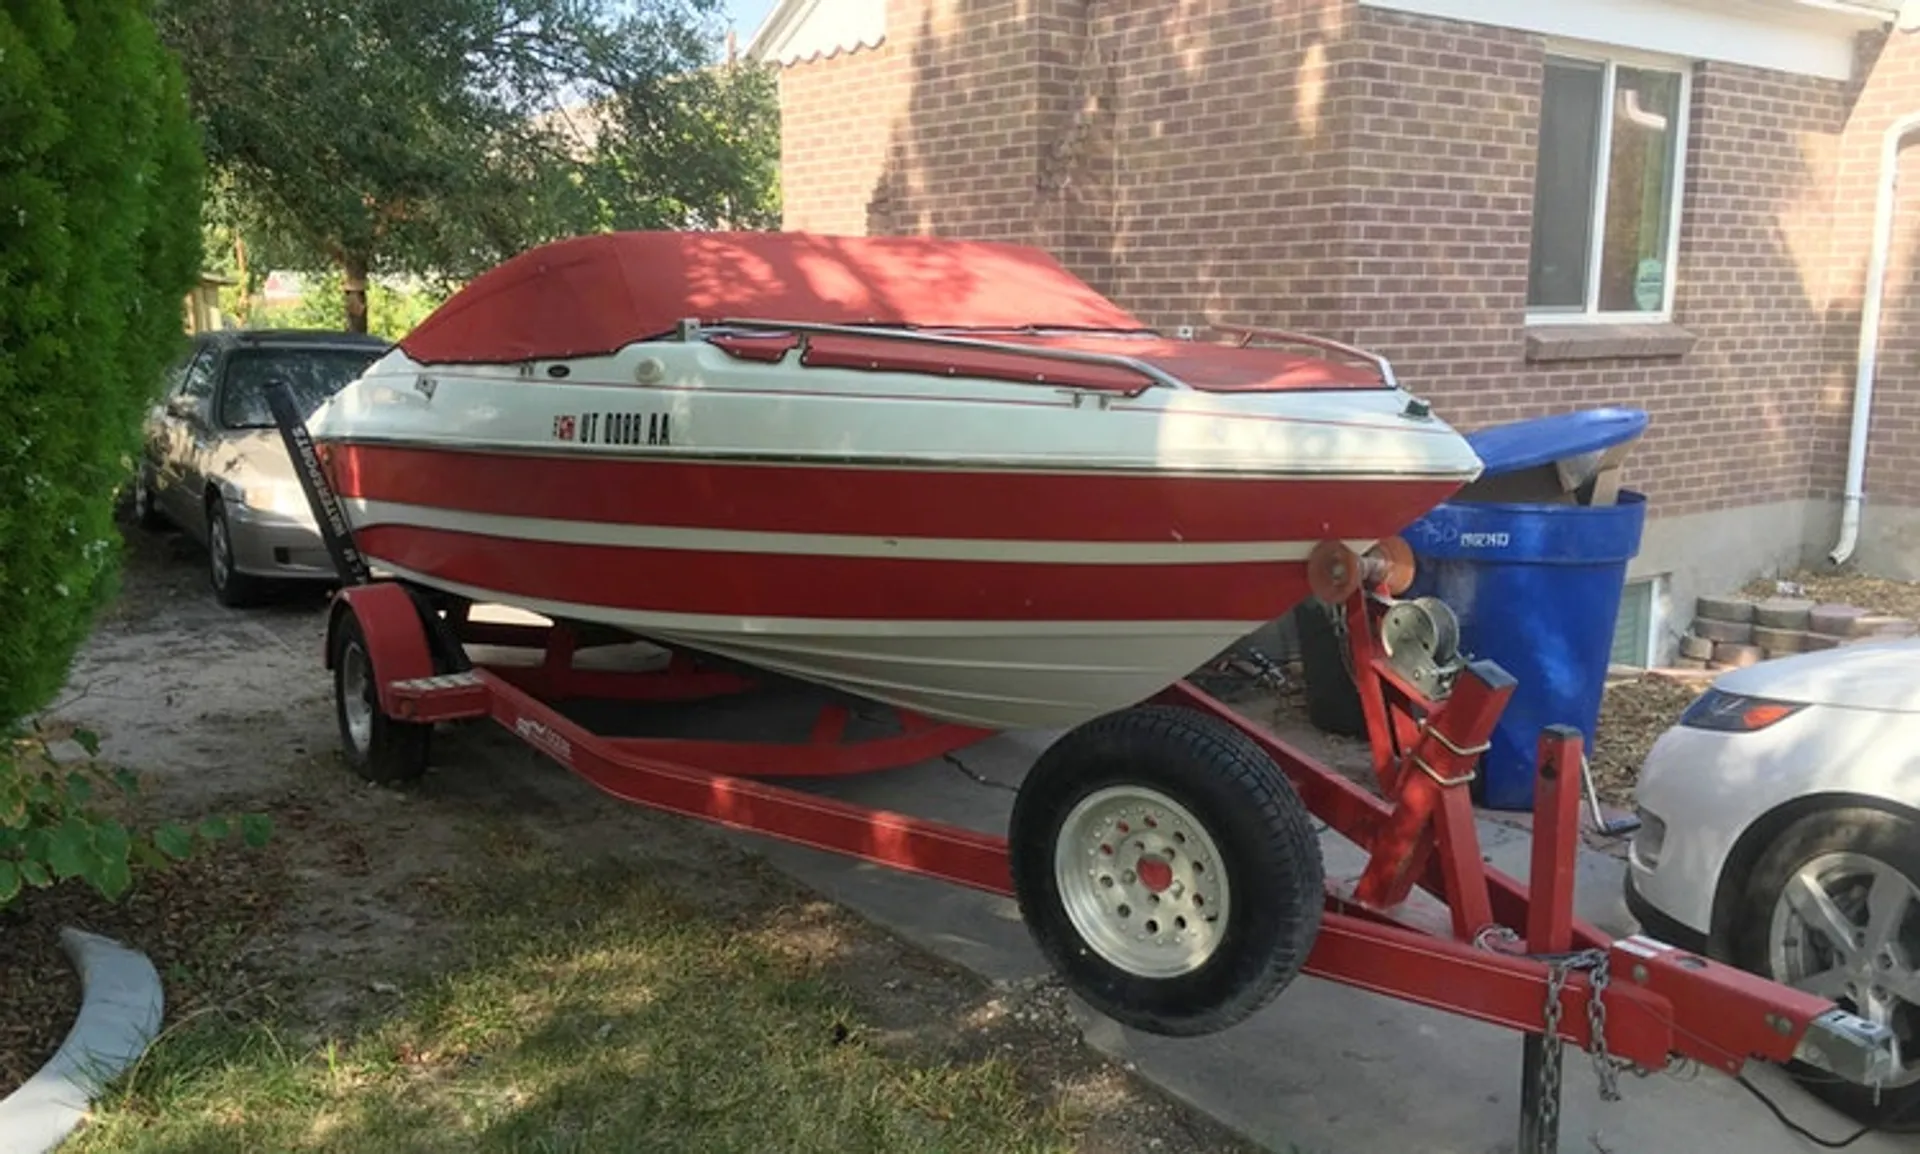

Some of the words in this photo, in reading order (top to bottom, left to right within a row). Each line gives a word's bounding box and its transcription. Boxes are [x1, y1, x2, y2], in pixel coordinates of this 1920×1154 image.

[580, 412, 599, 443] UT
[647, 412, 670, 446] AA
[291, 425, 347, 538] WATERSPORTS
